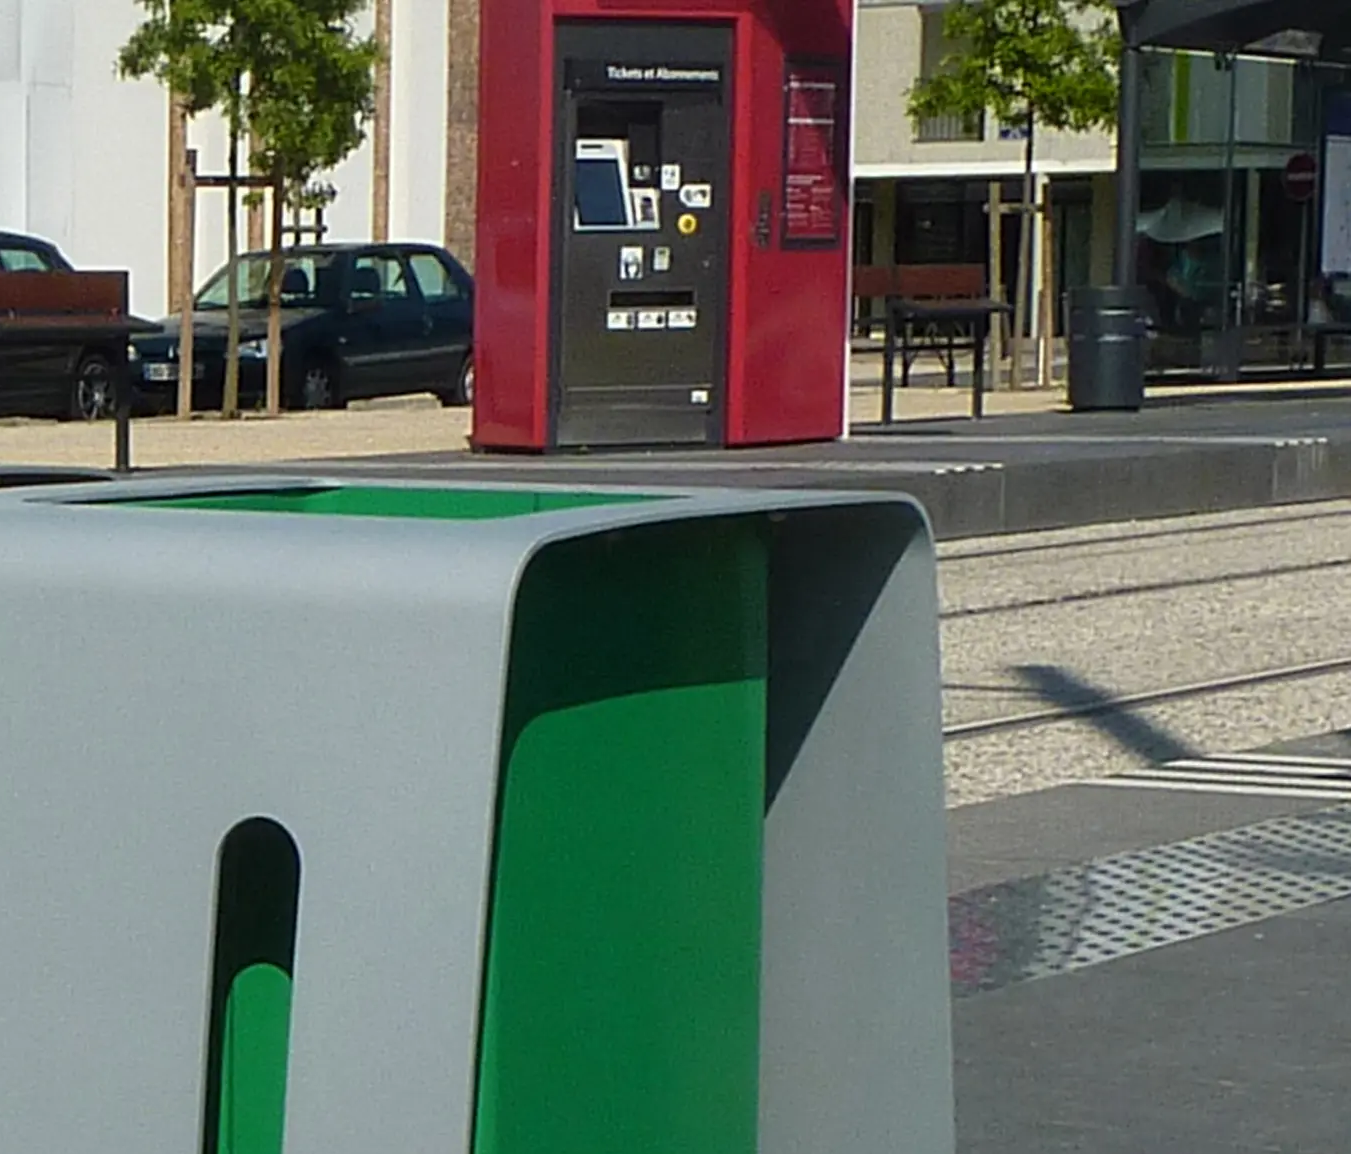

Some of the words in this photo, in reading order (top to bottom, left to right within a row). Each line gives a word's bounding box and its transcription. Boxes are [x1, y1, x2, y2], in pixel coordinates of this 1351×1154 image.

[607, 66, 643, 79] Tickets
[645, 68, 655, 79] et
[657, 66, 720, 80] Abonnements
